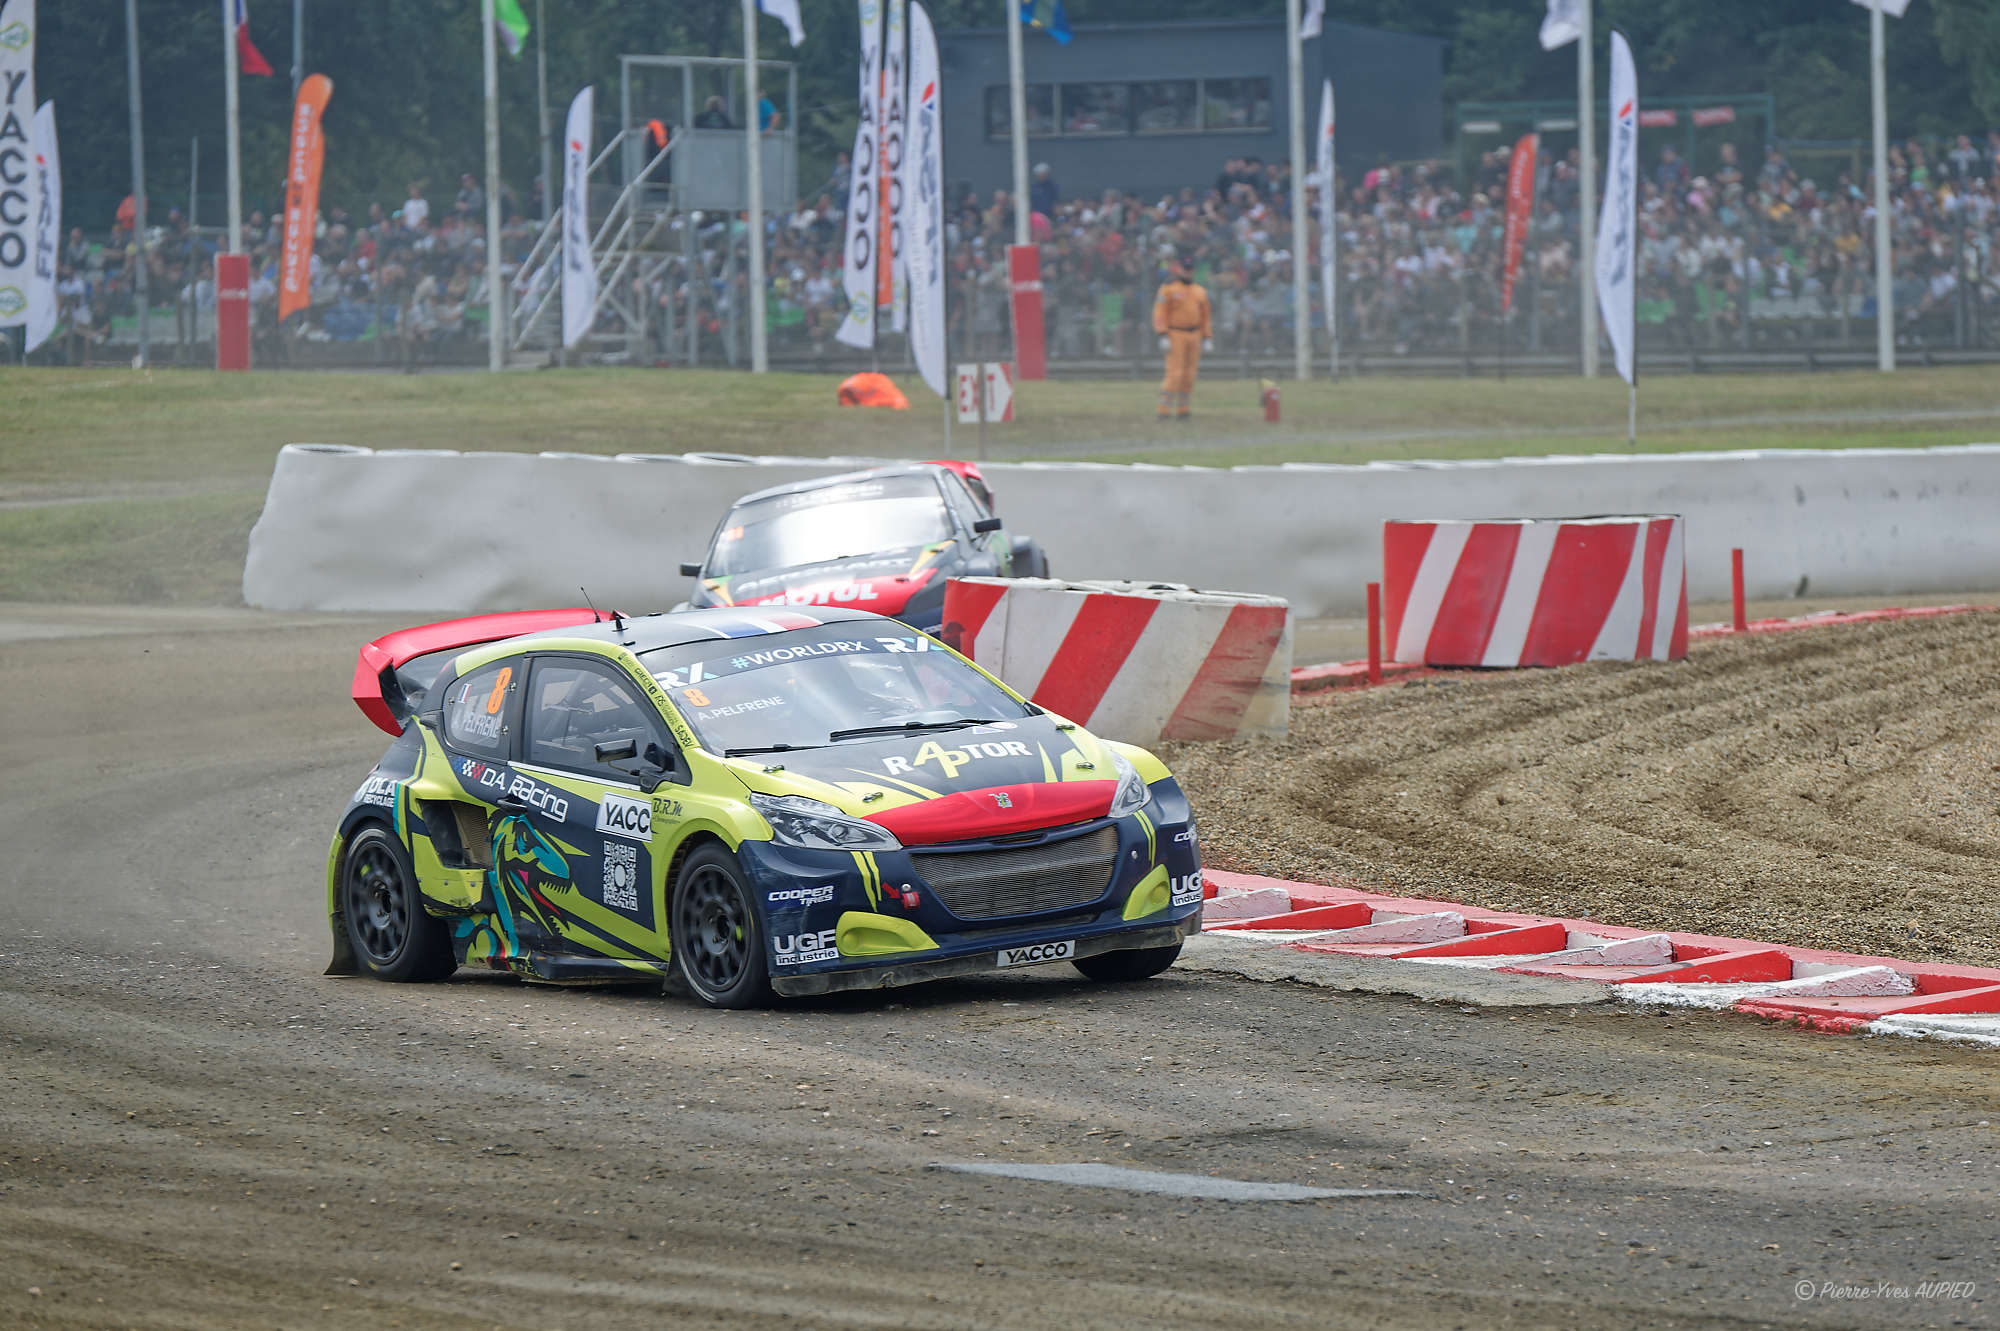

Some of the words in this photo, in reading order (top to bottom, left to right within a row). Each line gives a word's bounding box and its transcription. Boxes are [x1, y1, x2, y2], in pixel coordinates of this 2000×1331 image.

[0, 70, 27, 268] YACCO
[960, 373, 995, 412] EXT
[731, 641, 870, 669] #WORLDRX
[487, 667, 512, 714] 8
[682, 688, 711, 707] 8
[882, 741, 1033, 778] RAPTOR
[508, 774, 569, 824] Racing
[606, 802, 660, 834] YACC
[768, 886, 834, 902] COOPER
[800, 893, 833, 907] TIRES
[774, 929, 836, 954] UGF
[1006, 942, 1067, 964] YACCO
[778, 948, 836, 964] industrie
